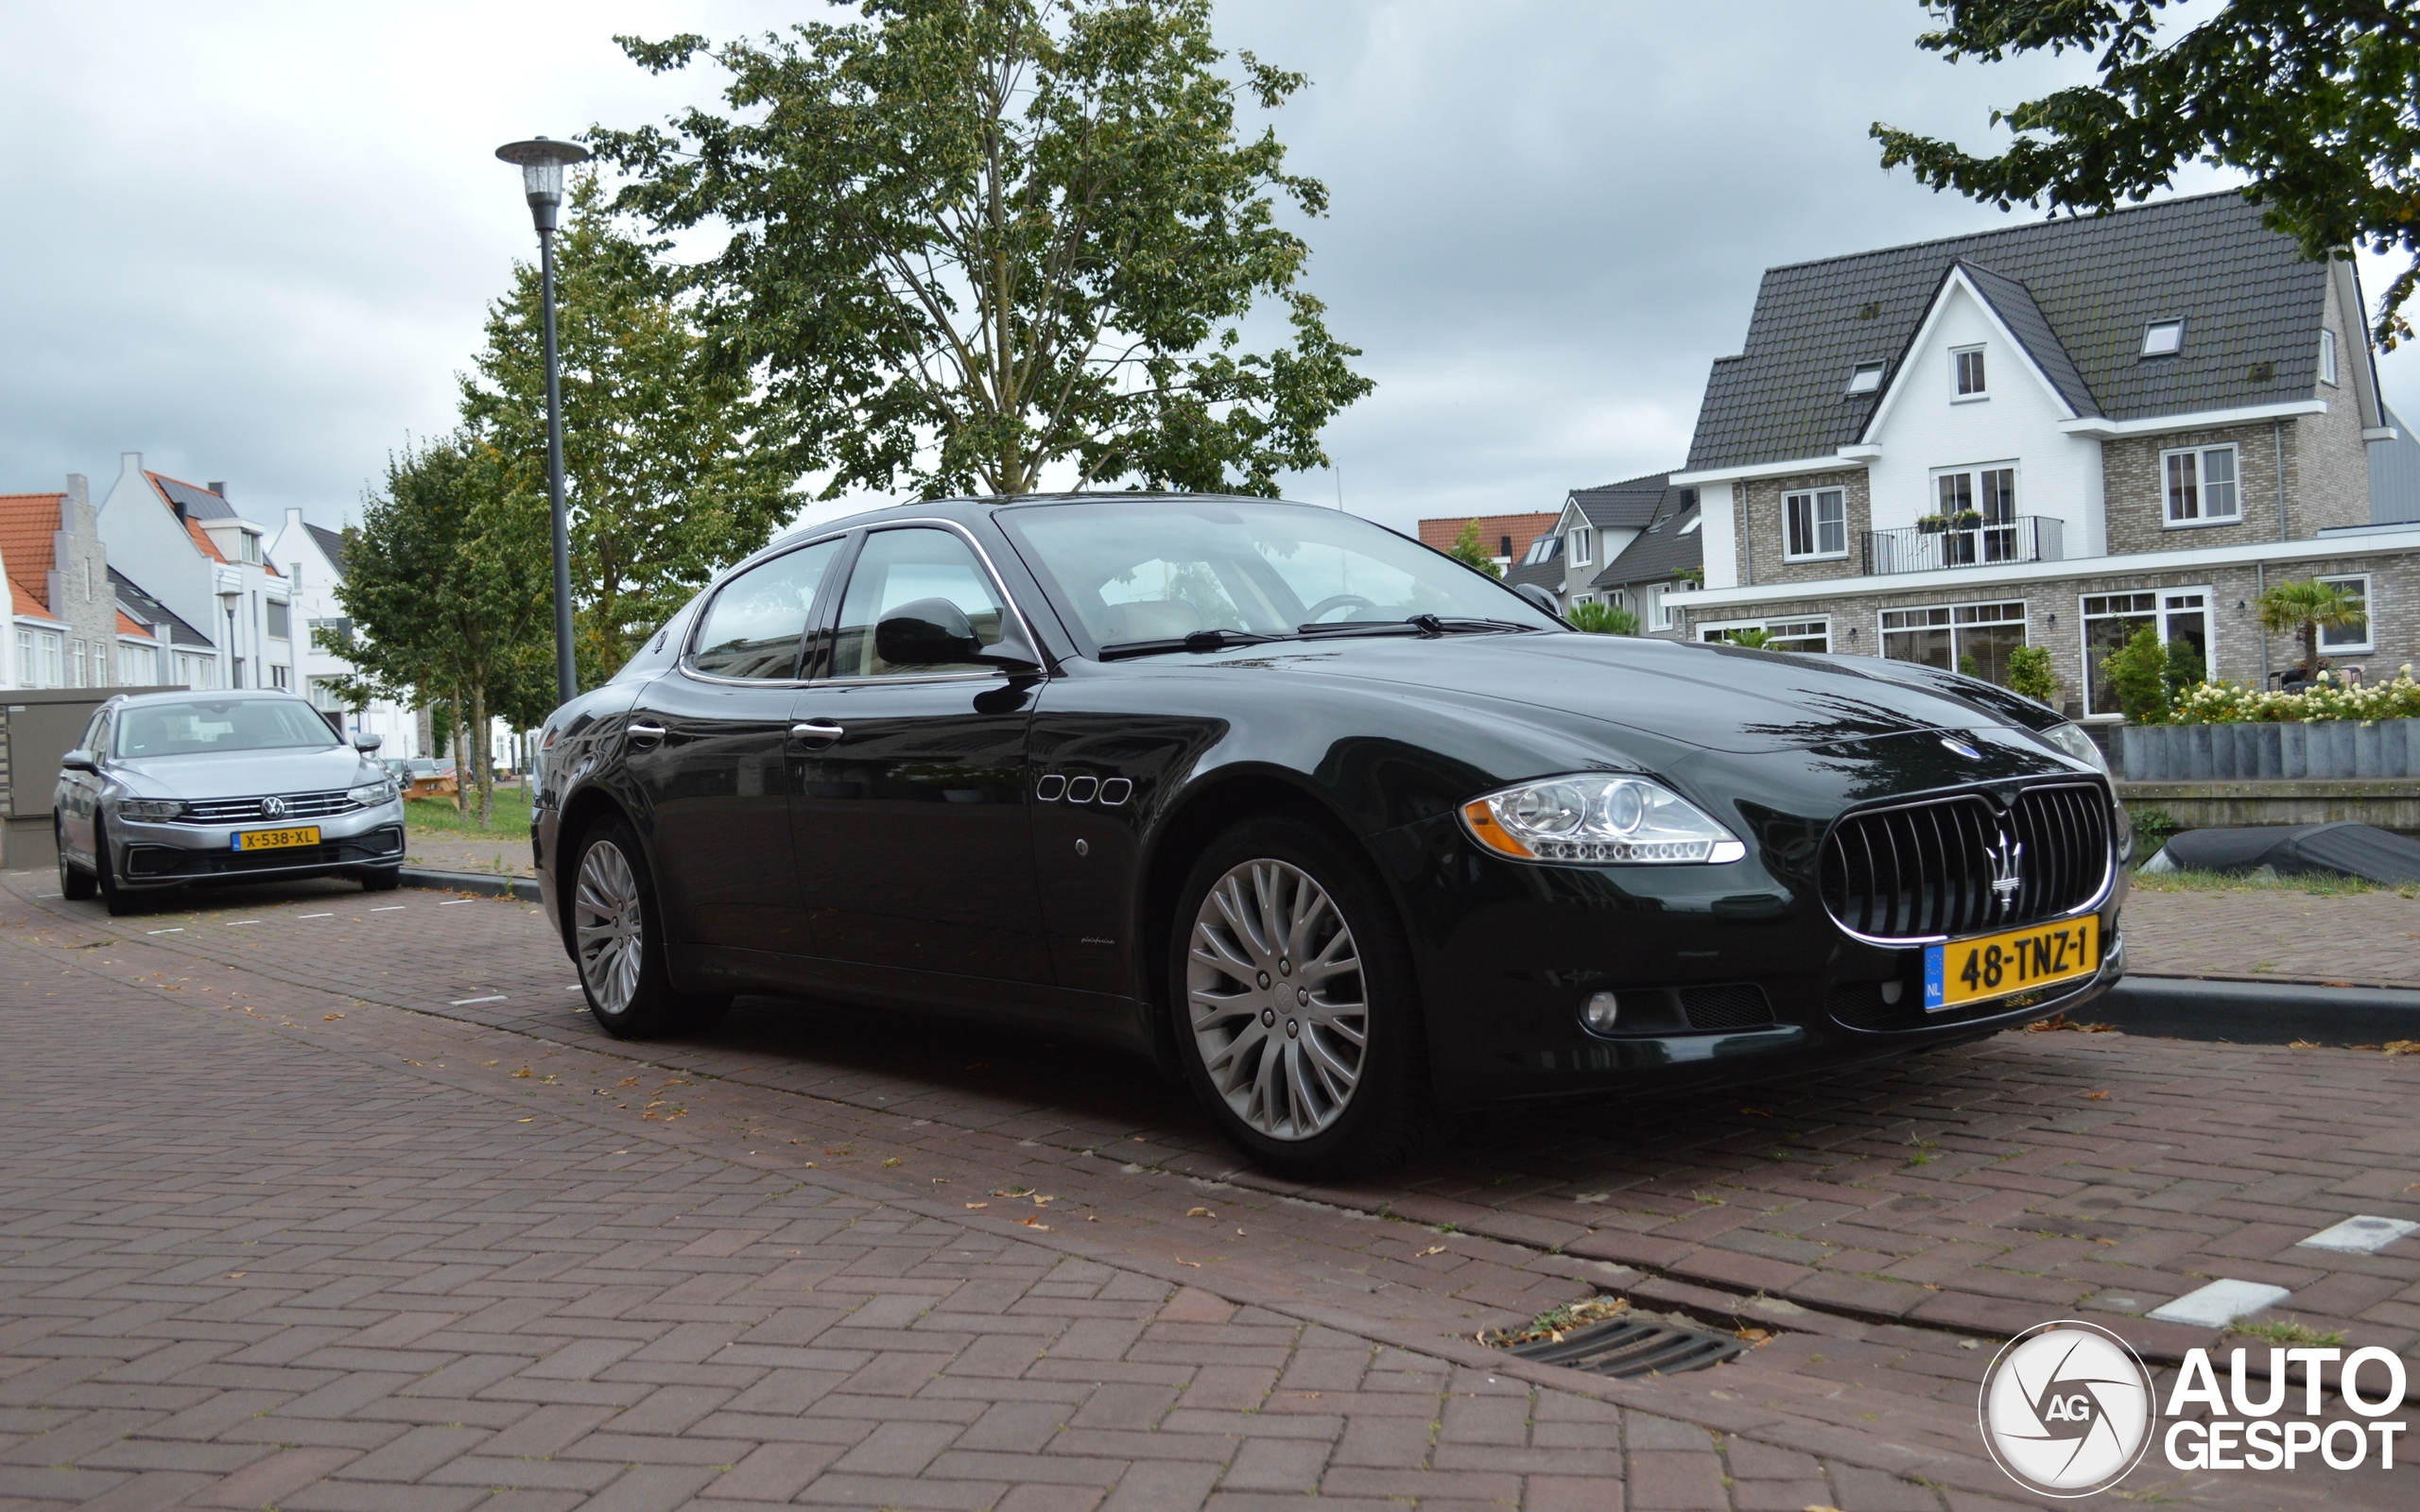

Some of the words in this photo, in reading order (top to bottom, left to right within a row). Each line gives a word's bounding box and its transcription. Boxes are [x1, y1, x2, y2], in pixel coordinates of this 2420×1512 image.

[246, 831, 314, 848] X-538-XL
[1927, 983, 1942, 997] NL
[1961, 926, 2086, 992] 48-TNZ-1
